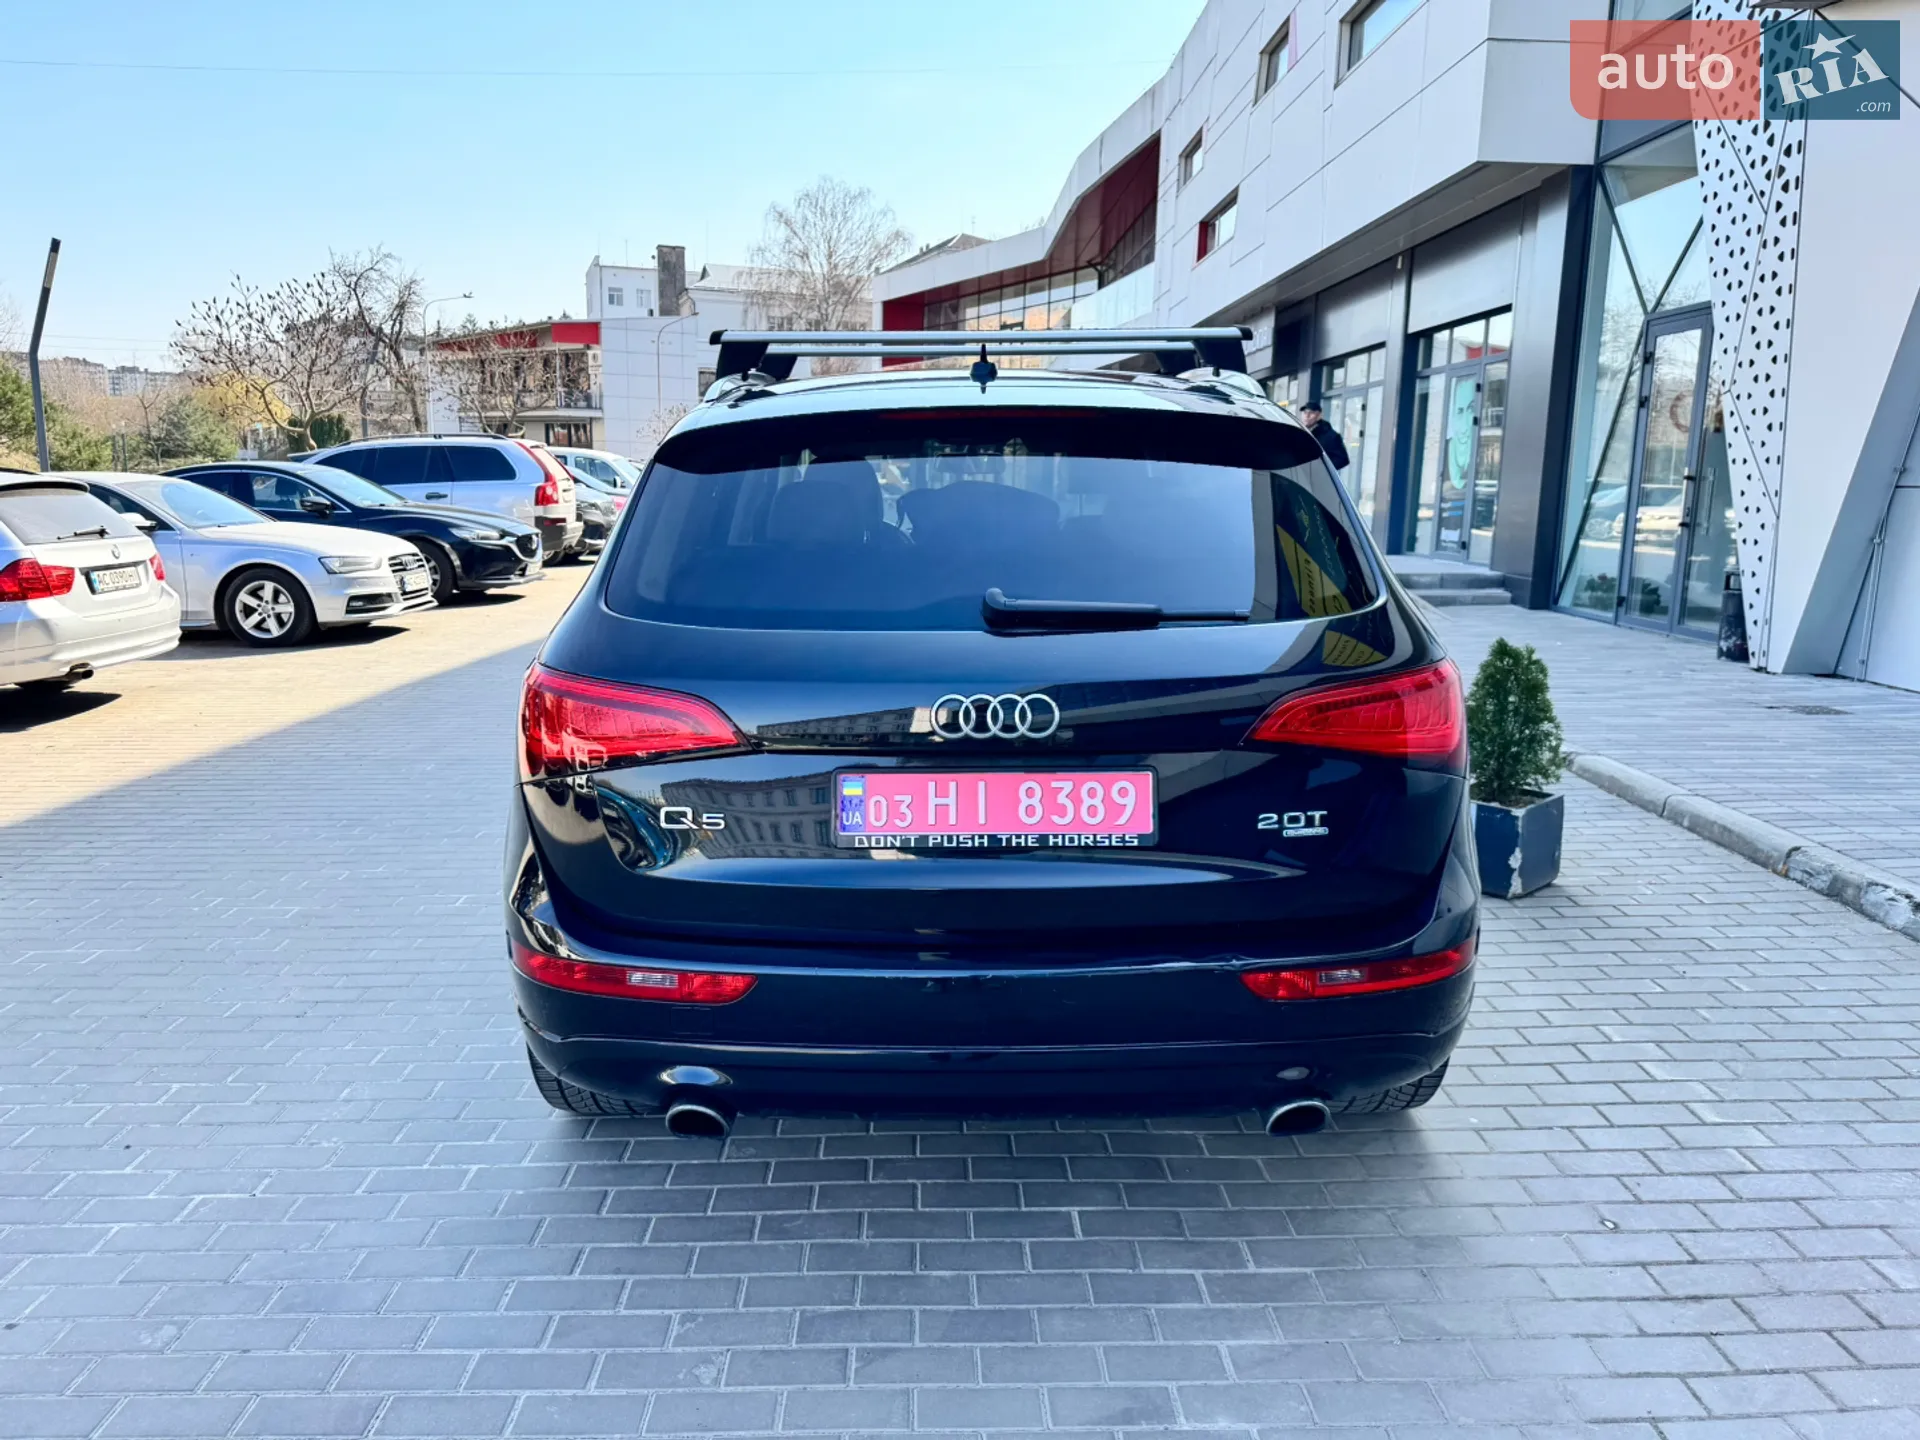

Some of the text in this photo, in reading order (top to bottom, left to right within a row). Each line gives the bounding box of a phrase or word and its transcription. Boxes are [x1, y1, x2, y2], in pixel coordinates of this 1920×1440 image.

[869, 794, 914, 828] 03
[1018, 780, 1137, 826] 8389
[660, 806, 726, 830] Q5
[842, 811, 863, 825] UA
[854, 834, 1139, 848] DON'T PUSH THE HORSES
